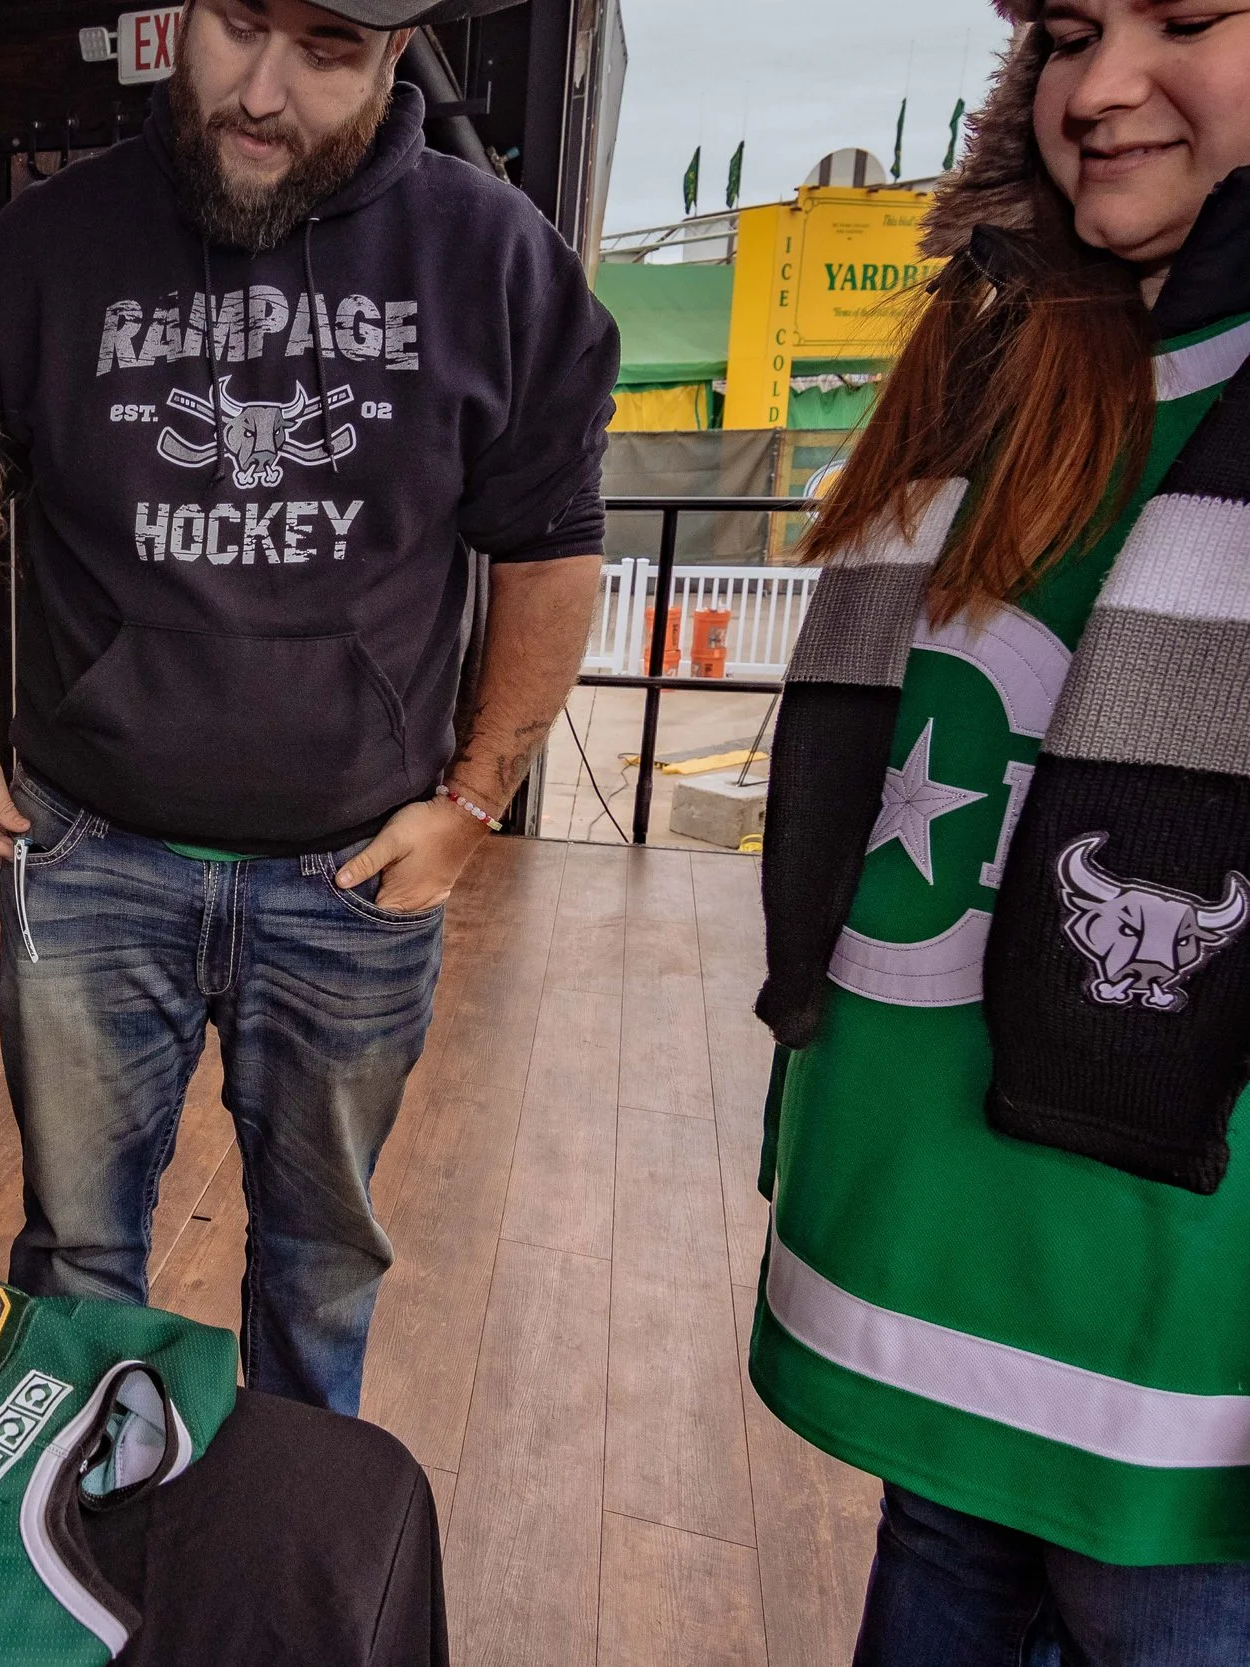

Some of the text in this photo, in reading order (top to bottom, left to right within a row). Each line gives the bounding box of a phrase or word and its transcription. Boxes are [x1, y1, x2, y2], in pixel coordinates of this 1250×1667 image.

[135, 12, 180, 70] EX
[96, 285, 419, 376] RAMPAGE
[768, 236, 792, 423] ICE COLD
[361, 401, 393, 419] 02
[134, 500, 365, 565] HOCKEY
